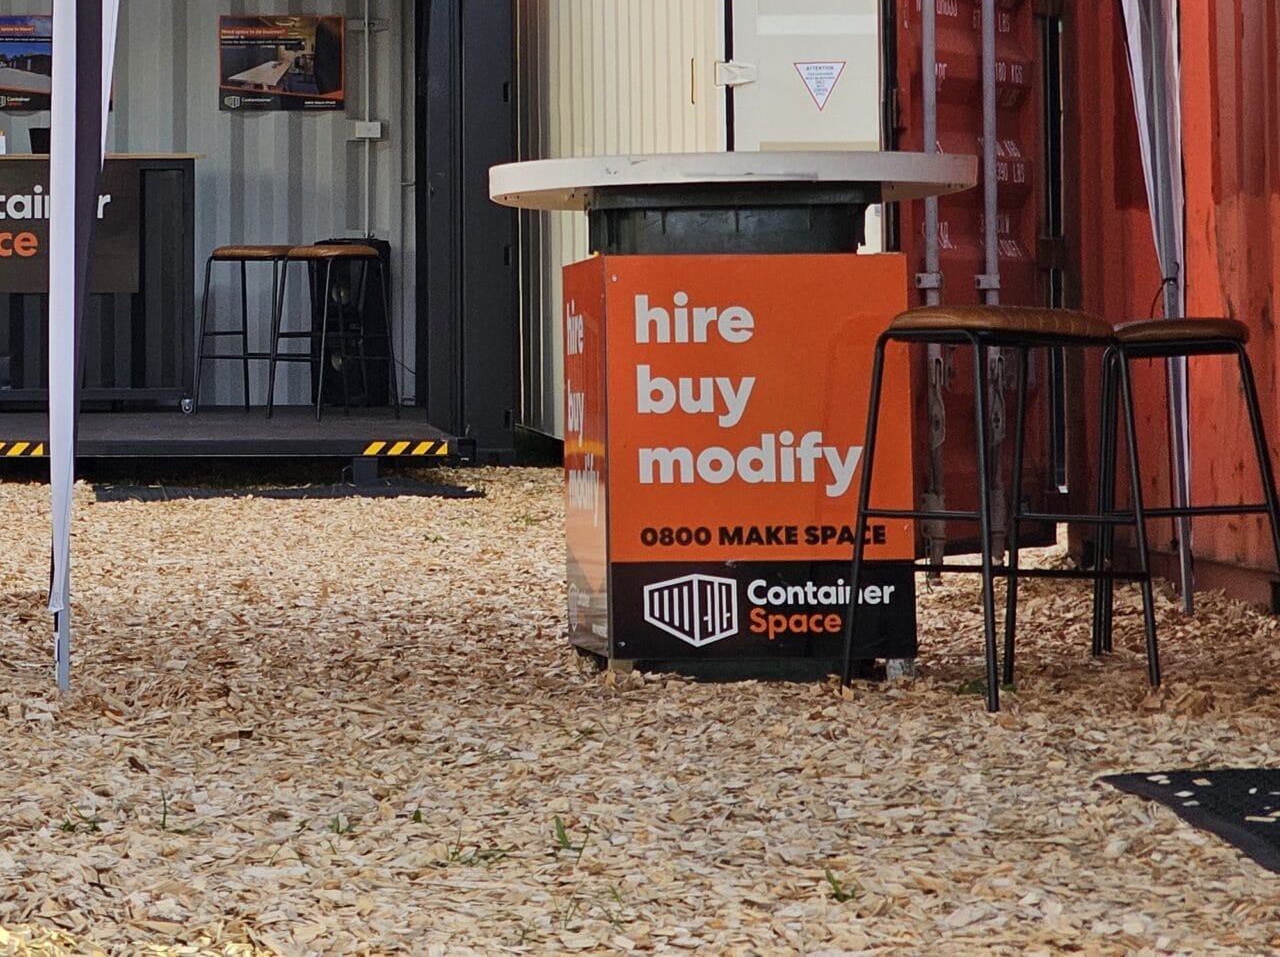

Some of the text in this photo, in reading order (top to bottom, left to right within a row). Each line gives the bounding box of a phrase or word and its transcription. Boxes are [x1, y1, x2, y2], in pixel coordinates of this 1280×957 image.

[566, 298, 584, 356] hire
[634, 291, 755, 343] hire
[567, 378, 585, 449] buy
[636, 364, 757, 428] buy
[638, 430, 864, 498] modify
[640, 526, 712, 547] 0800
[718, 525, 799, 546] MAKE
[749, 607, 843, 640] Space
